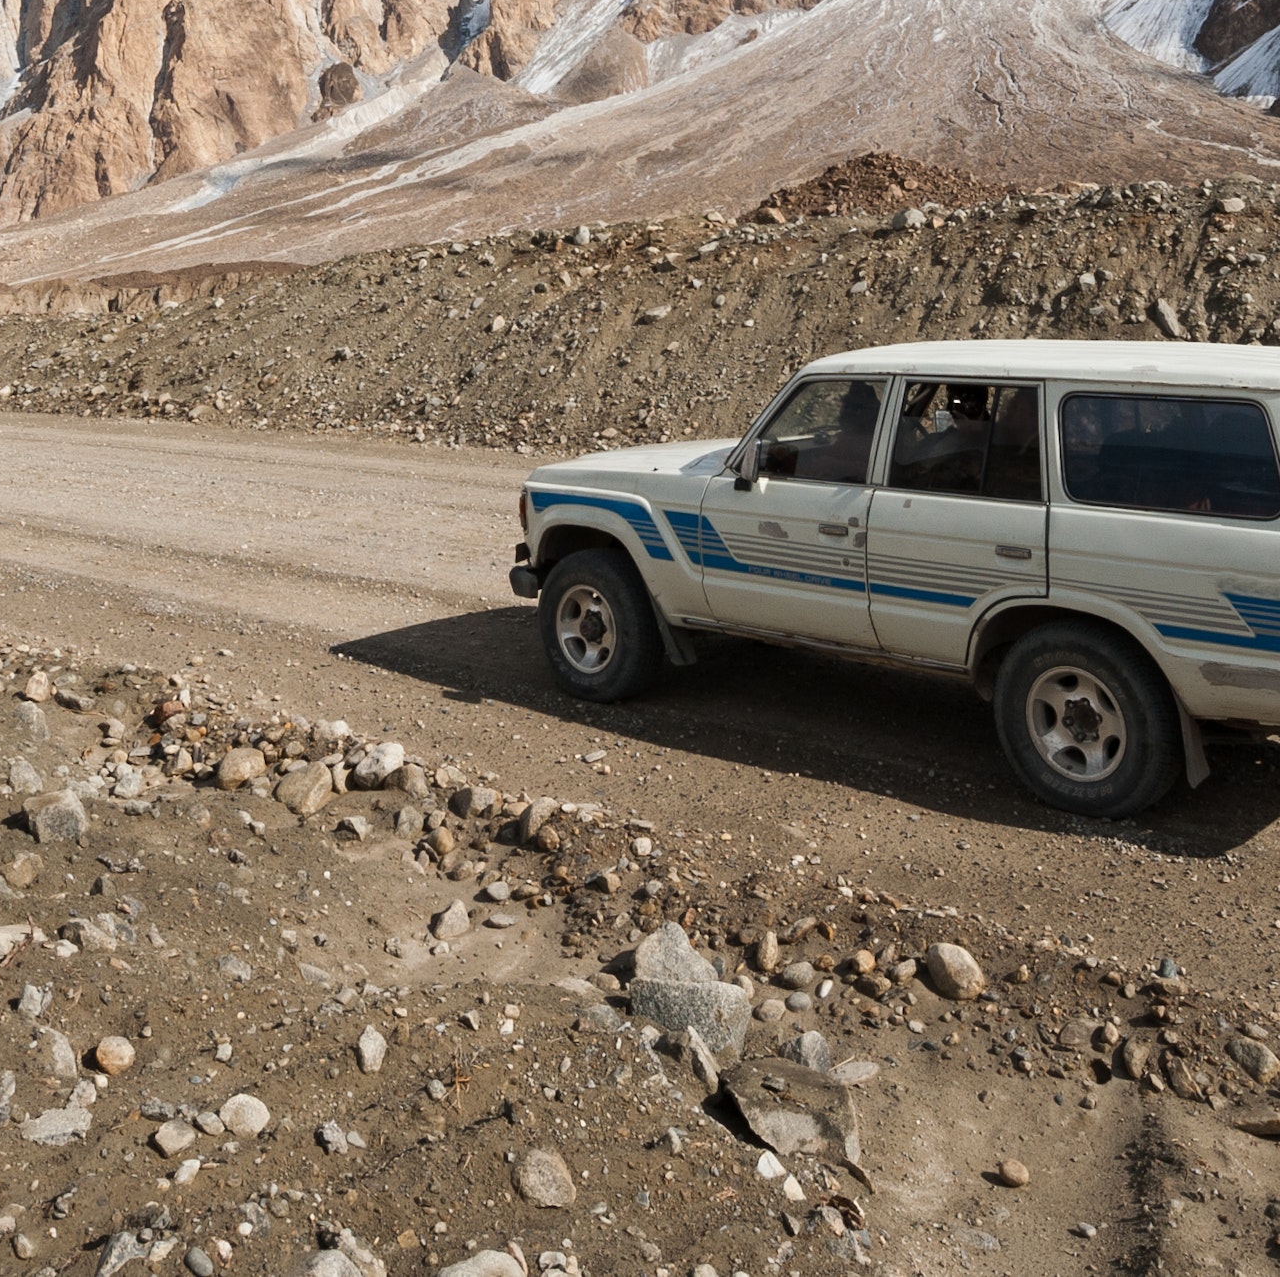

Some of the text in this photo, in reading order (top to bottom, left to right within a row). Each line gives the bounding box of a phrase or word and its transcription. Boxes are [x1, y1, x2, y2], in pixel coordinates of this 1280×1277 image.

[748, 565, 832, 586] FOUR WHEEL DRIVE
